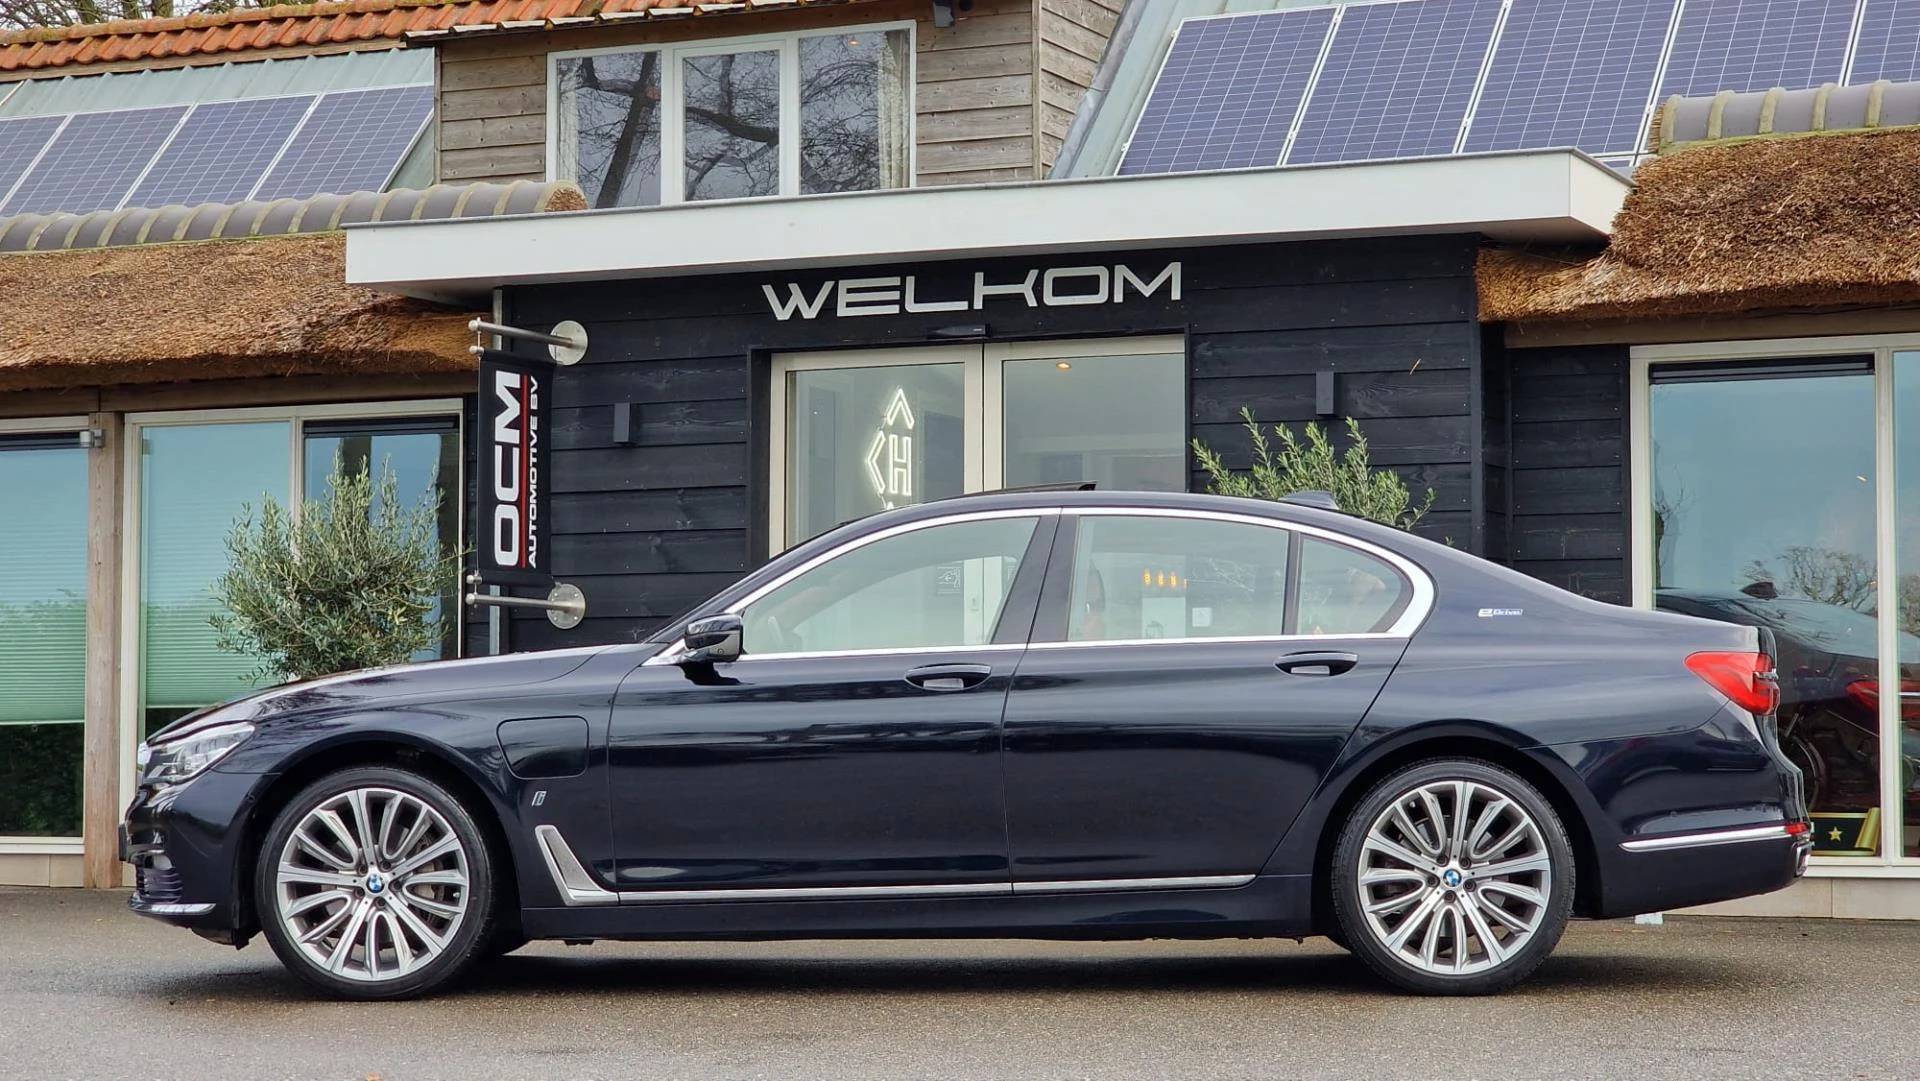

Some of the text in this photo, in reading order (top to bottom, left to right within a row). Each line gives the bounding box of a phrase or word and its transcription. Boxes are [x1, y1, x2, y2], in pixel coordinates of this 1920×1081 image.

[761, 261, 1182, 321] WELKOM
[494, 370, 521, 567] OCM
[528, 375, 539, 569] AUTOMOTIVE BV
